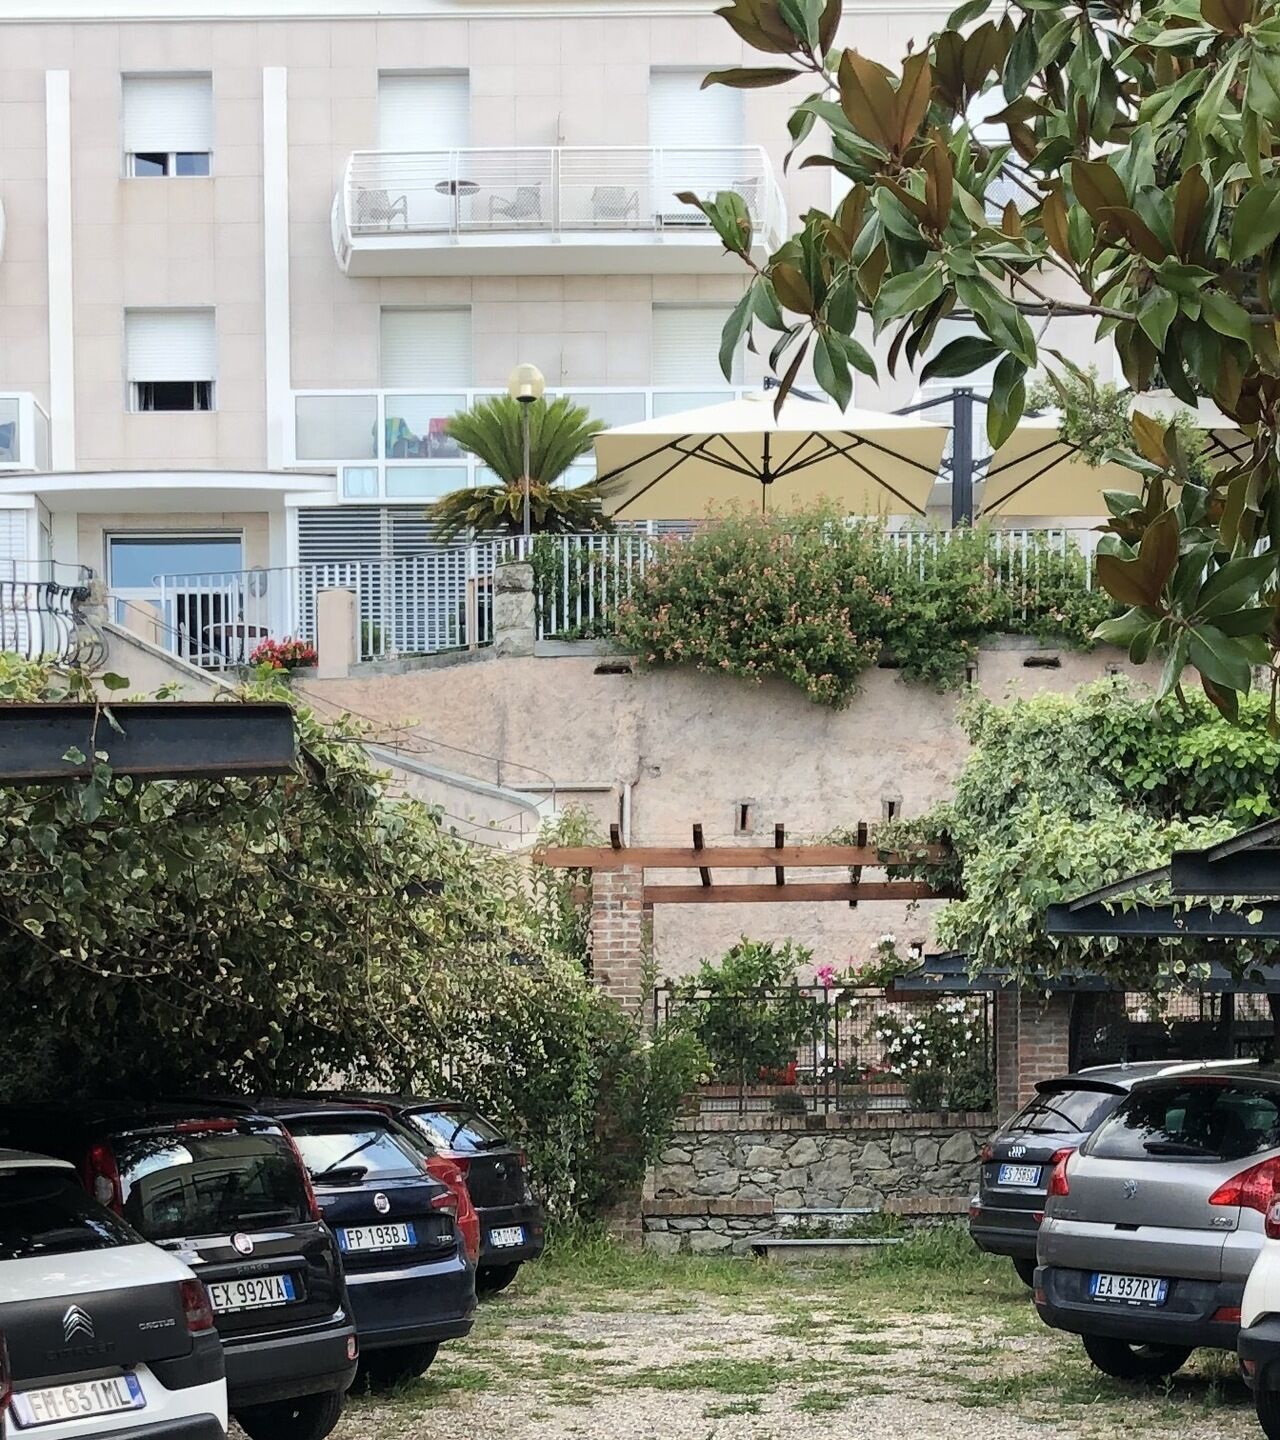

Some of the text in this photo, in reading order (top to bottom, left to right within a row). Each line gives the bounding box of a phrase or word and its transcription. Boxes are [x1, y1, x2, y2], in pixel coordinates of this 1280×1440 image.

[347, 1225, 409, 1249] FP 193BJ
[210, 1278, 285, 1307] EX 992VA
[1097, 1275, 1113, 1295] EA
[1117, 1277, 1158, 1299] 937RY
[138, 1317, 176, 1331] CACTUS
[27, 1379, 131, 1421] FM 631ML
